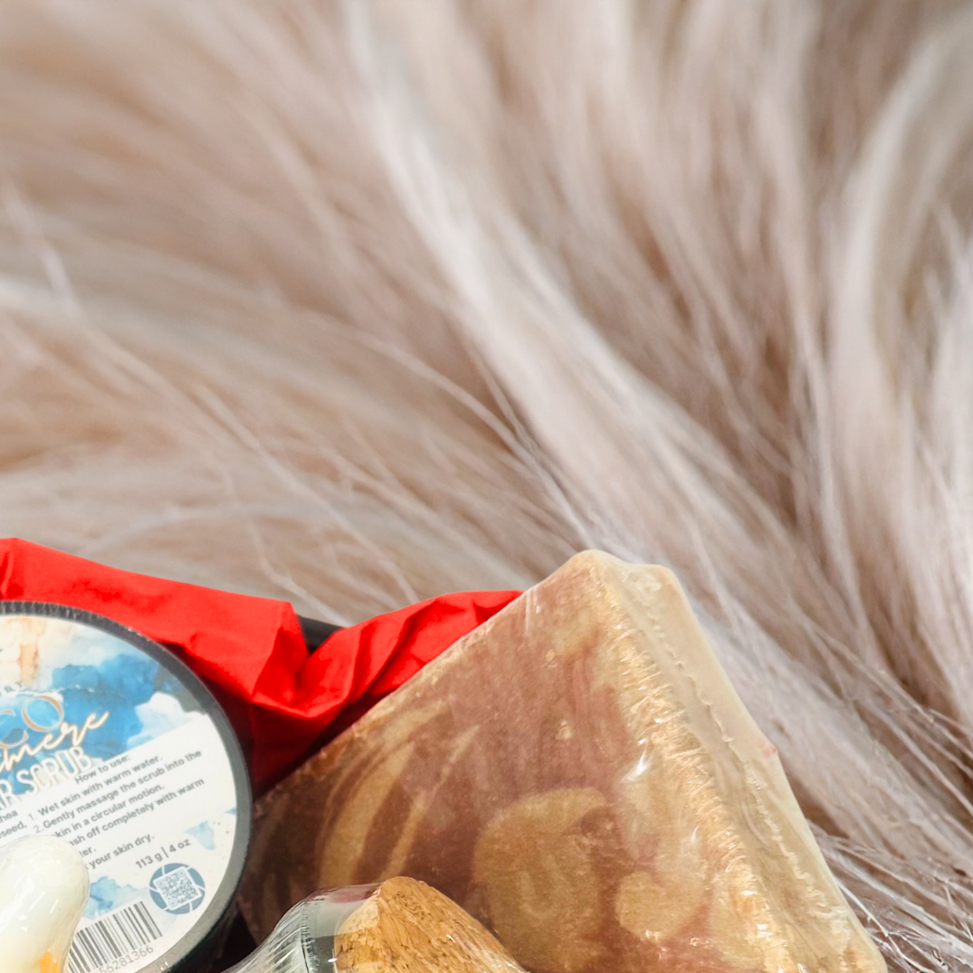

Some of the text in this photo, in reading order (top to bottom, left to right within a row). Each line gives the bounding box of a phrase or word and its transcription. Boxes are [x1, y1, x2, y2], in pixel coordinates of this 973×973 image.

[17, 744, 93, 795] SCRUB
[37, 756, 163, 816] Wet skin with warm water.
[43, 751, 202, 829] Gently massage the scrub into the
[74, 755, 130, 784] How to use:
[71, 822, 82, 831] in
[91, 801, 126, 822] circular
[128, 784, 165, 804] motion.
[86, 779, 205, 839] off completely with warm
[89, 853, 111, 870] your
[113, 843, 134, 856] skin
[134, 834, 155, 846] dry.
[135, 839, 191, 868] 113 g 4 oz
